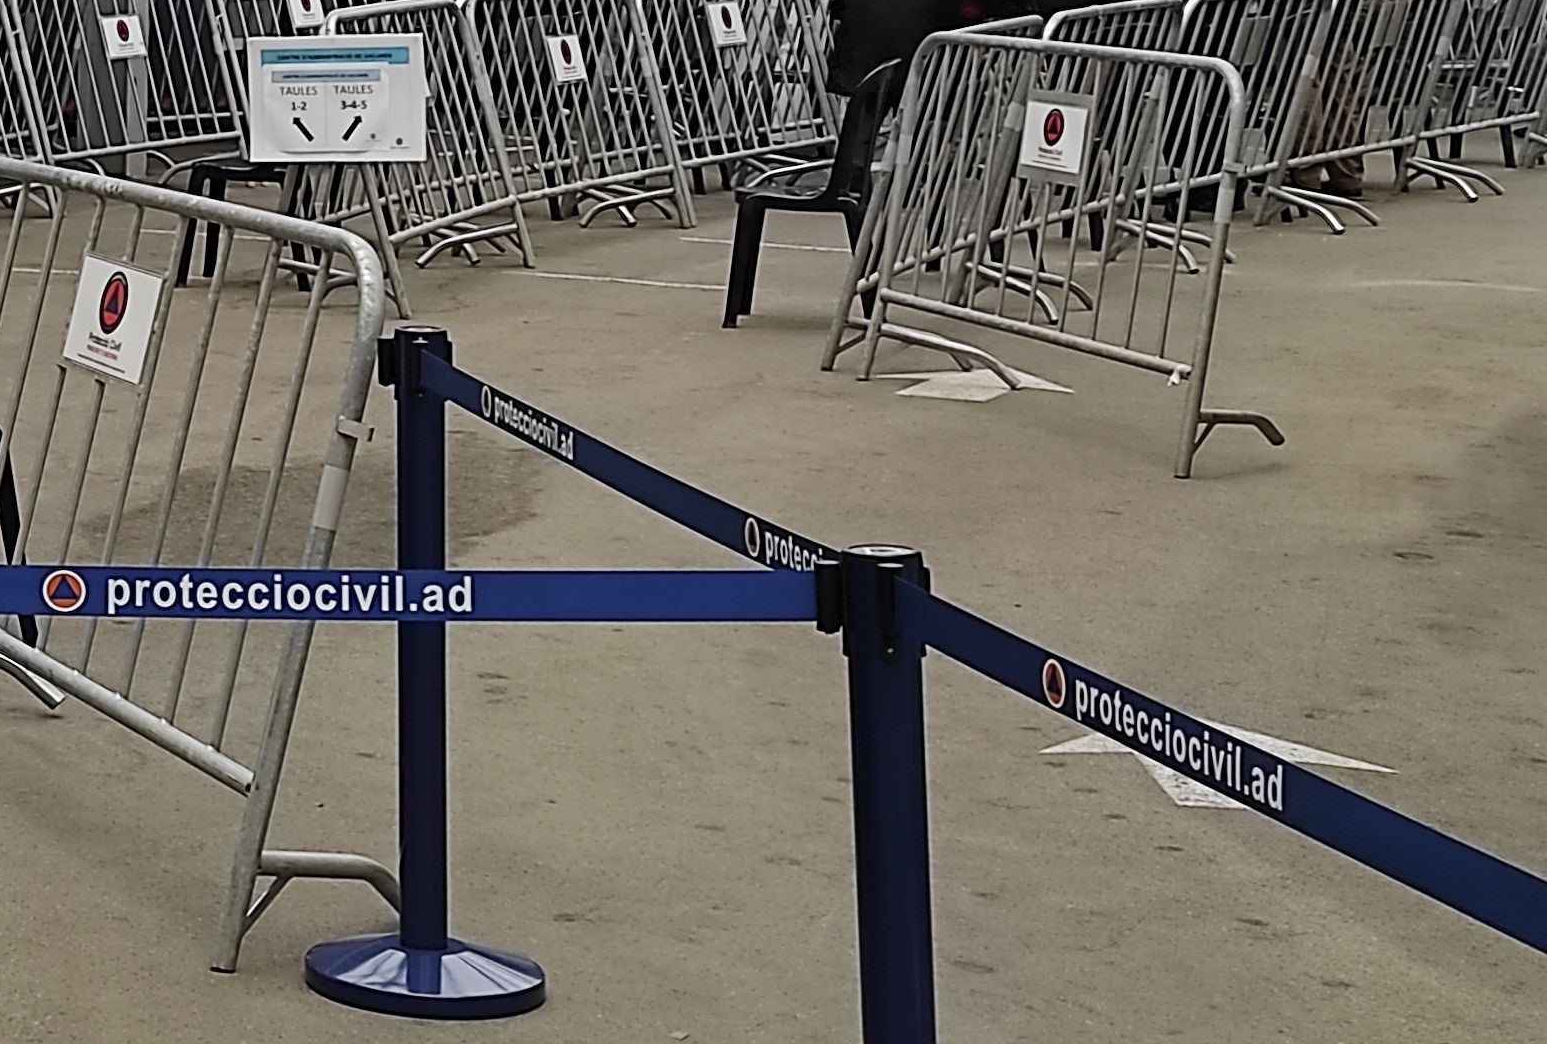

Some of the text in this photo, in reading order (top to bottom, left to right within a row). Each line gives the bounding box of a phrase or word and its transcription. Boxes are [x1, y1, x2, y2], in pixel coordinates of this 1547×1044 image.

[279, 86, 318, 96] TAULES
[334, 84, 374, 95] TAULES
[291, 101, 307, 111] 1-2
[341, 100, 368, 110] 3-4-5
[107, 573, 474, 615] protecciocivil.ad
[1075, 679, 1284, 811] protecciocivil.ad
